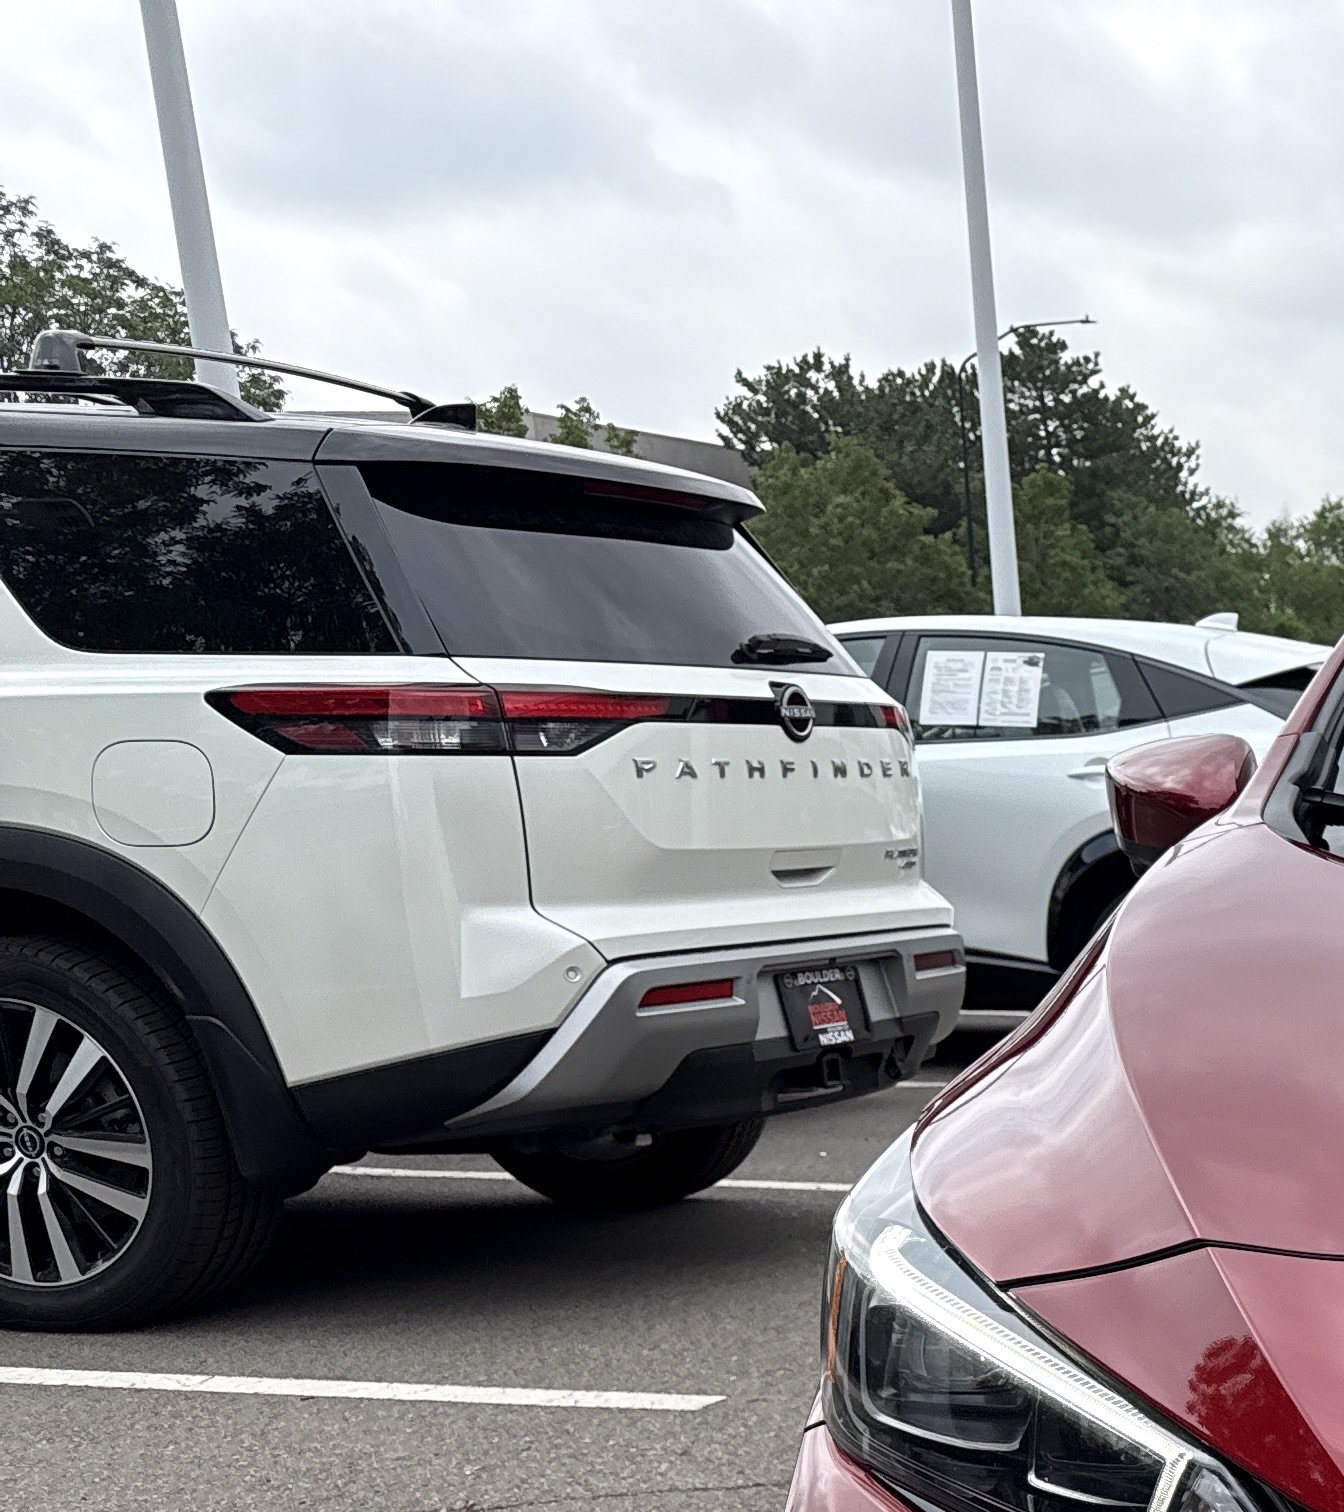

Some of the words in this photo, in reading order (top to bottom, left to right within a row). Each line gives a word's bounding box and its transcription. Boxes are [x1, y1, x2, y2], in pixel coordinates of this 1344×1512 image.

[780, 707, 816, 718] NISSAN
[632, 757, 911, 779] PATHFINDER
[797, 968, 841, 985] BOULDER
[818, 1028, 855, 1046] NISSAN
